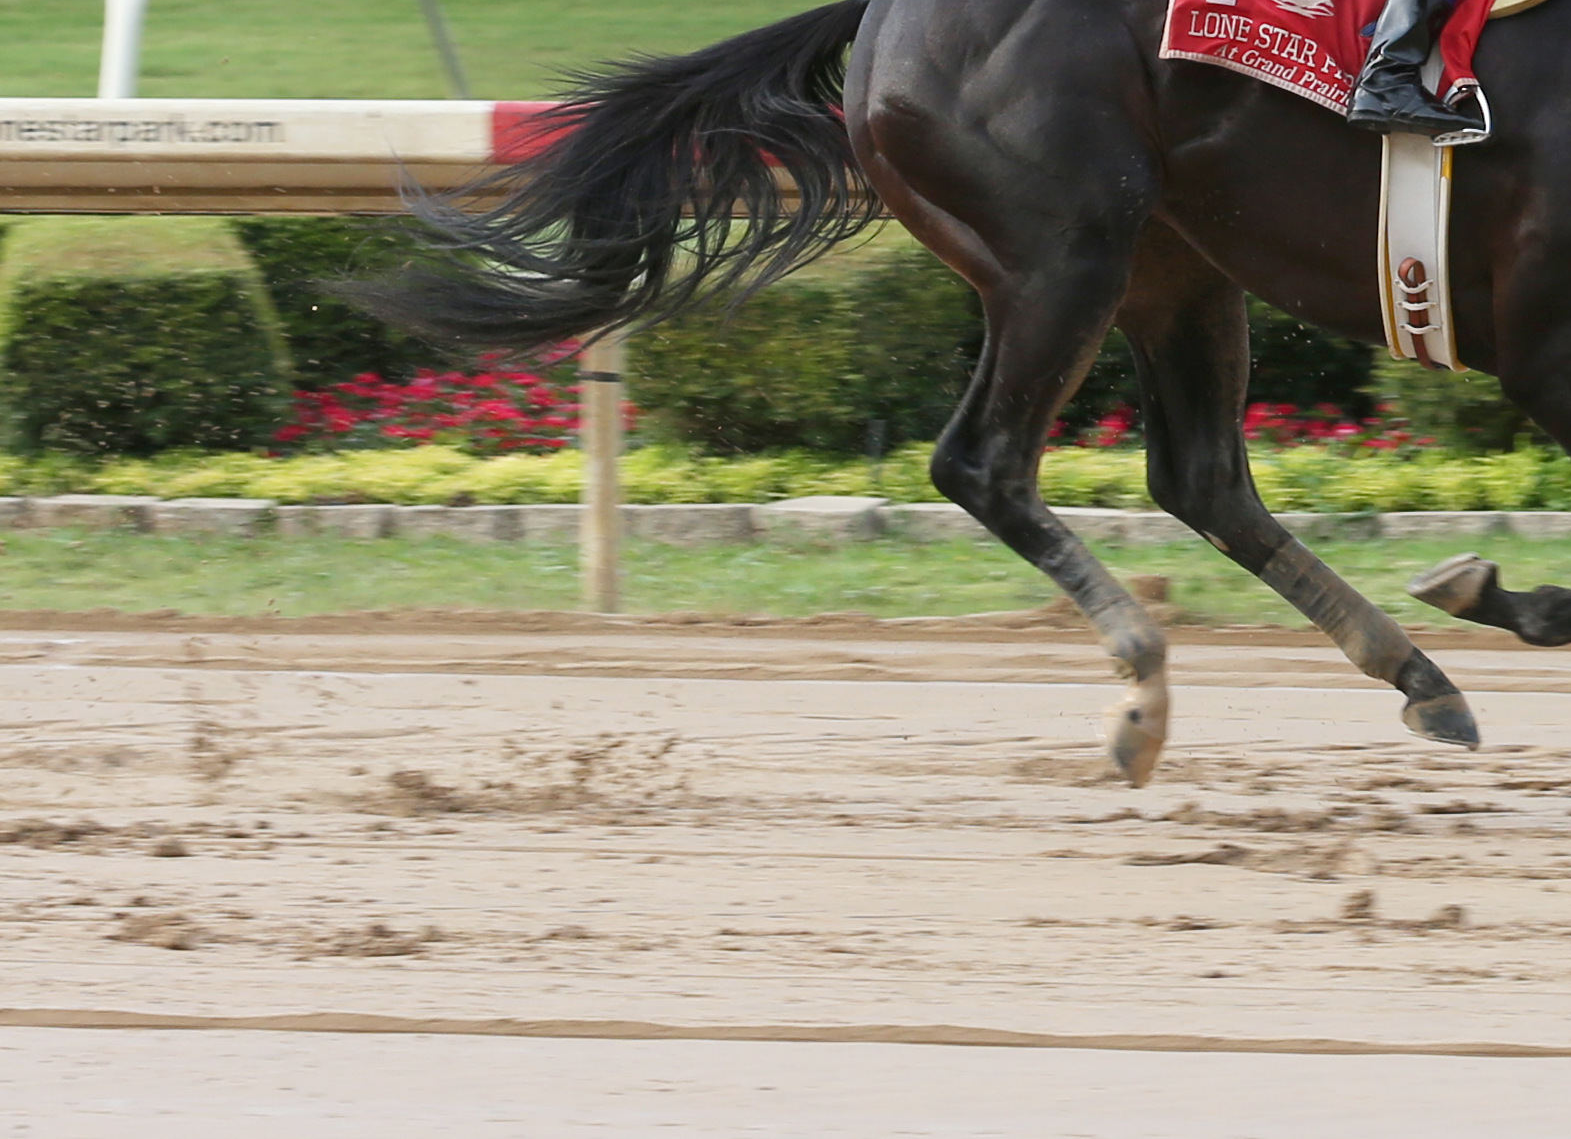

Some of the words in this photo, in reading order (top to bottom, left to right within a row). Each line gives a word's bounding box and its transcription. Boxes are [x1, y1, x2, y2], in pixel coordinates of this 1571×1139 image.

[1188, 10, 1254, 43] LONE
[1254, 23, 1318, 68] STAR
[1214, 43, 1239, 60] At
[1241, 49, 1299, 81] Grand
